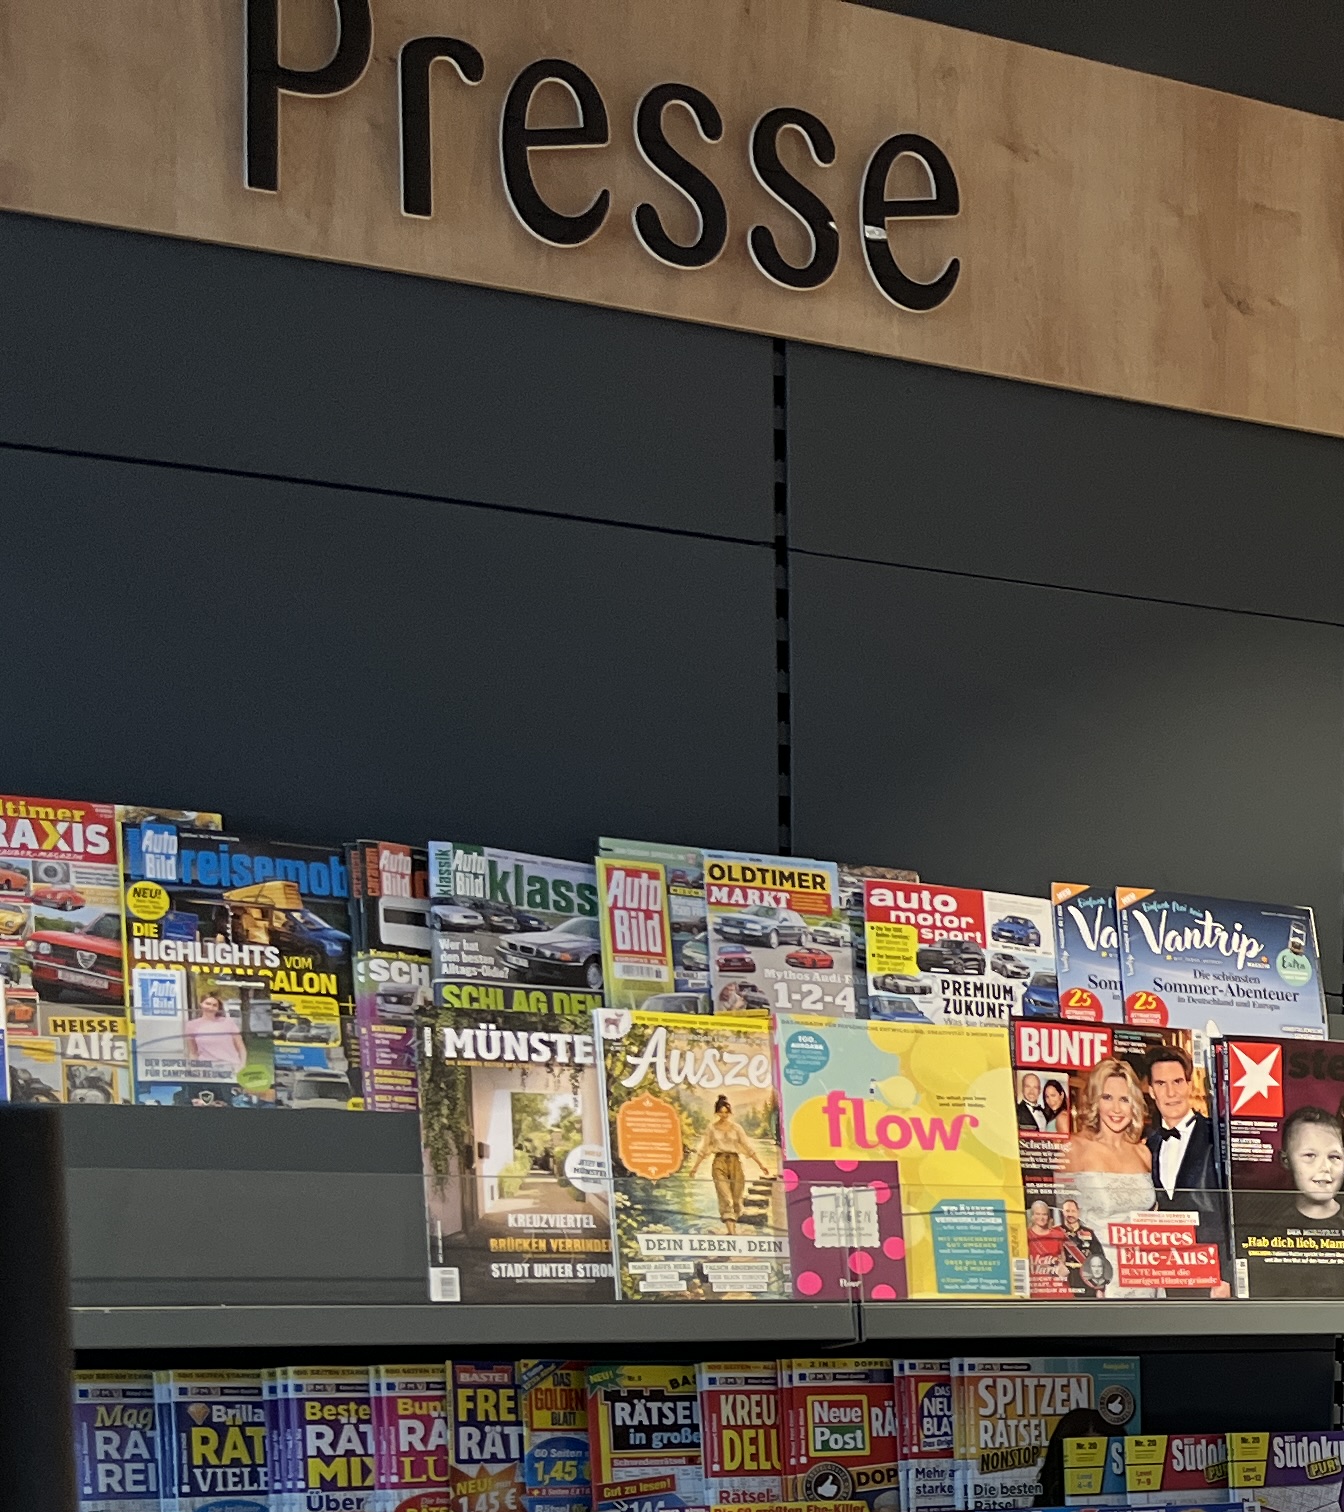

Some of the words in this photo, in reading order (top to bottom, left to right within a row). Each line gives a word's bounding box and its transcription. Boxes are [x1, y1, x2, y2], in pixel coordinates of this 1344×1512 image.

[243, 0, 963, 312] Presse
[708, 863, 827, 892] OLDTIMER
[608, 870, 662, 912] Auto
[710, 885, 791, 908] MARKT
[869, 888, 958, 913] auto
[132, 922, 158, 938] DIE
[891, 910, 973, 927] motor
[614, 910, 663, 953] Bild
[920, 927, 983, 944] sport
[1134, 909, 1264, 970] Vantrip
[133, 938, 280, 967] HIGHLIGHTS
[284, 956, 312, 970] VOM
[1193, 969, 1208, 980] Die
[1210, 971, 1260, 985] schönsten
[442, 985, 549, 1014] SCHLAG
[774, 984, 855, 1015] 1-2-4
[941, 979, 1014, 1001] PREMIUM
[1153, 977, 1299, 1002] Sommer-Abenteuer
[52, 1019, 120, 1034] HEISSE
[1020, 1026, 1108, 1066] BUNTE
[822, 1090, 980, 1152] flow
[507, 1214, 597, 1229] KREUZVIERTEL
[645, 1238, 683, 1252] DEIN
[689, 1238, 743, 1253] LEBEN,
[748, 1240, 783, 1253] DEIN
[1111, 1228, 1193, 1245] Bitteres
[1271, 1238, 1294, 1249] dich
[1296, 1238, 1318, 1251] lieb,
[1121, 1246, 1216, 1266] Ehe-Aus!
[491, 1263, 530, 1278] STADT
[533, 1263, 573, 1278] UNTER
[459, 1371, 509, 1383] BASTEI
[978, 1377, 1089, 1415] SPITZEN
[813, 1402, 861, 1423] Neue
[815, 1428, 864, 1450] Post
[980, 1417, 1050, 1448] RÄTSEL
[980, 1448, 1040, 1472] NONSTOP
